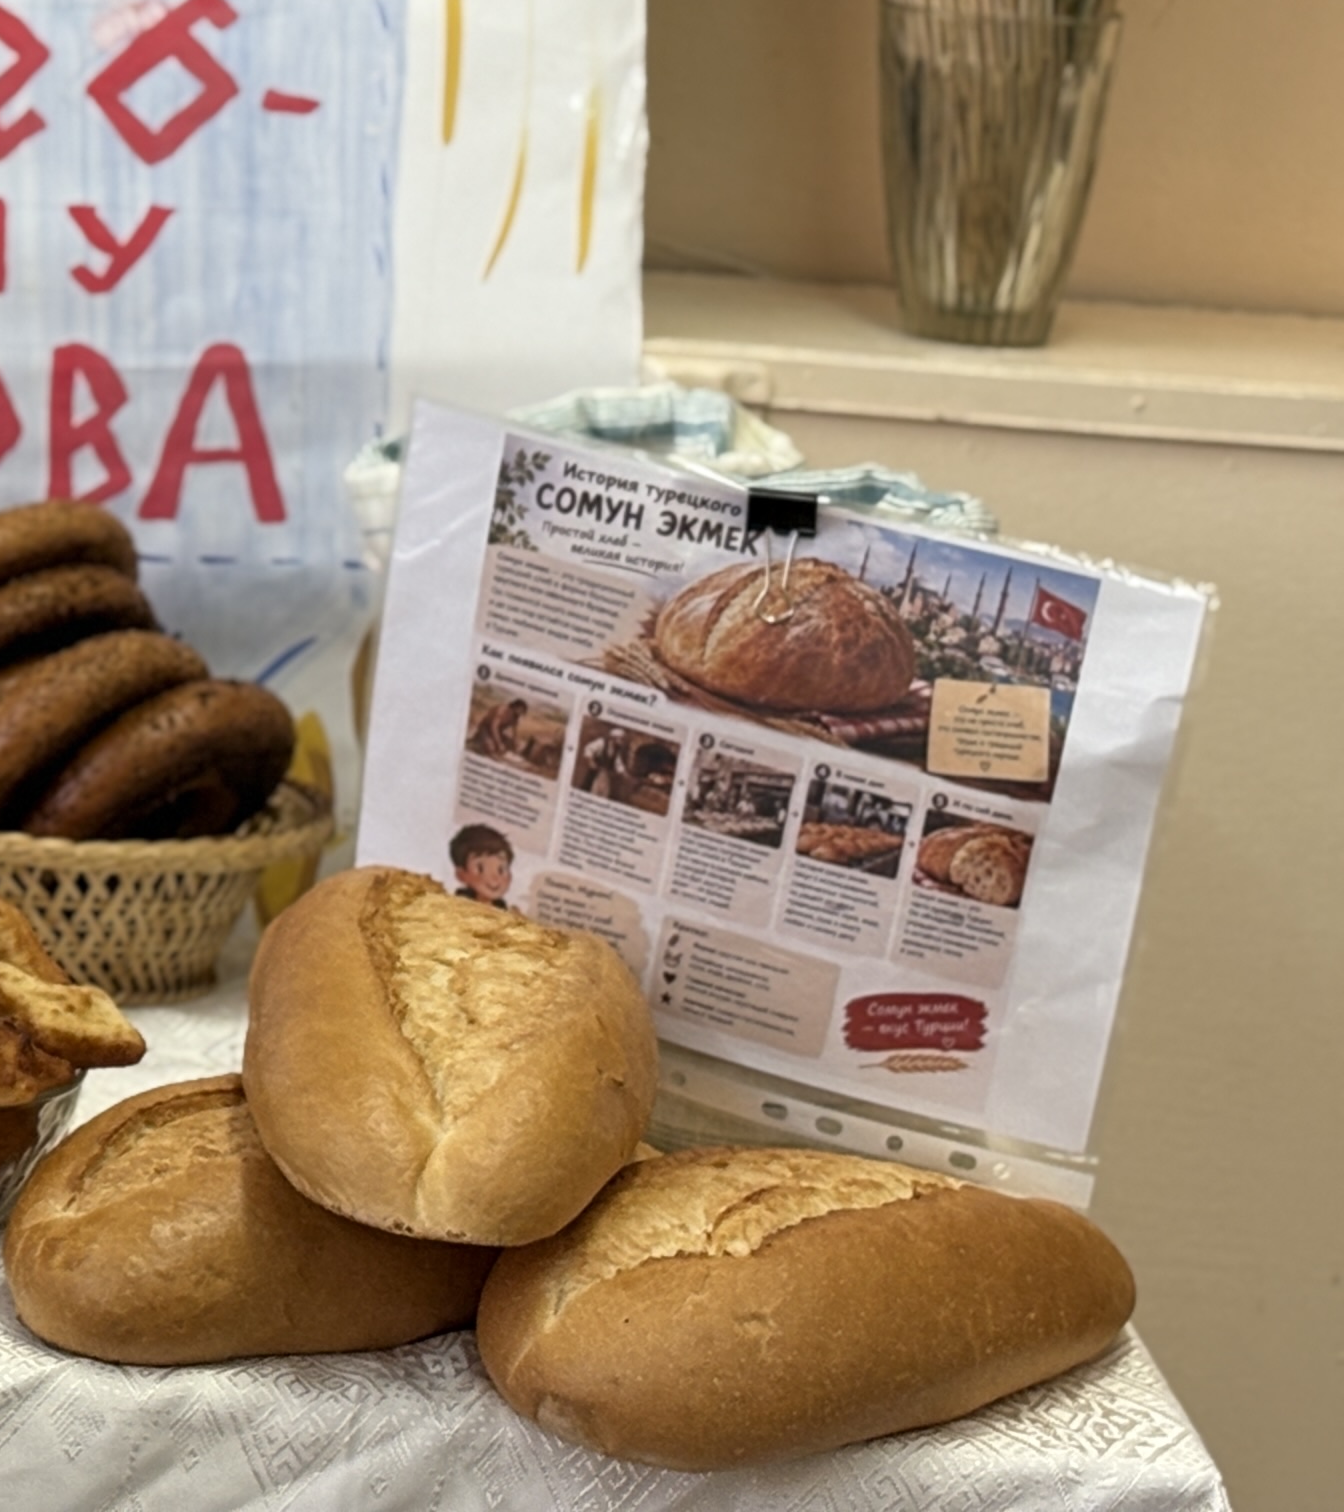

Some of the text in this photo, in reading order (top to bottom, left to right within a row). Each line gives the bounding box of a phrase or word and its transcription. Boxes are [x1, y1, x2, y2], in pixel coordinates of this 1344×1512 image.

[563, 461, 743, 518] История турецкого
[536, 482, 762, 557] СОМУН ЭКМЕК
[541, 520, 594, 542] Простой
[598, 532, 629, 548] хлеб
[570, 544, 685, 574] великая история!
[508, 653, 564, 679] появился
[567, 673, 606, 693] сомун
[867, 1001, 912, 1019] Сомун
